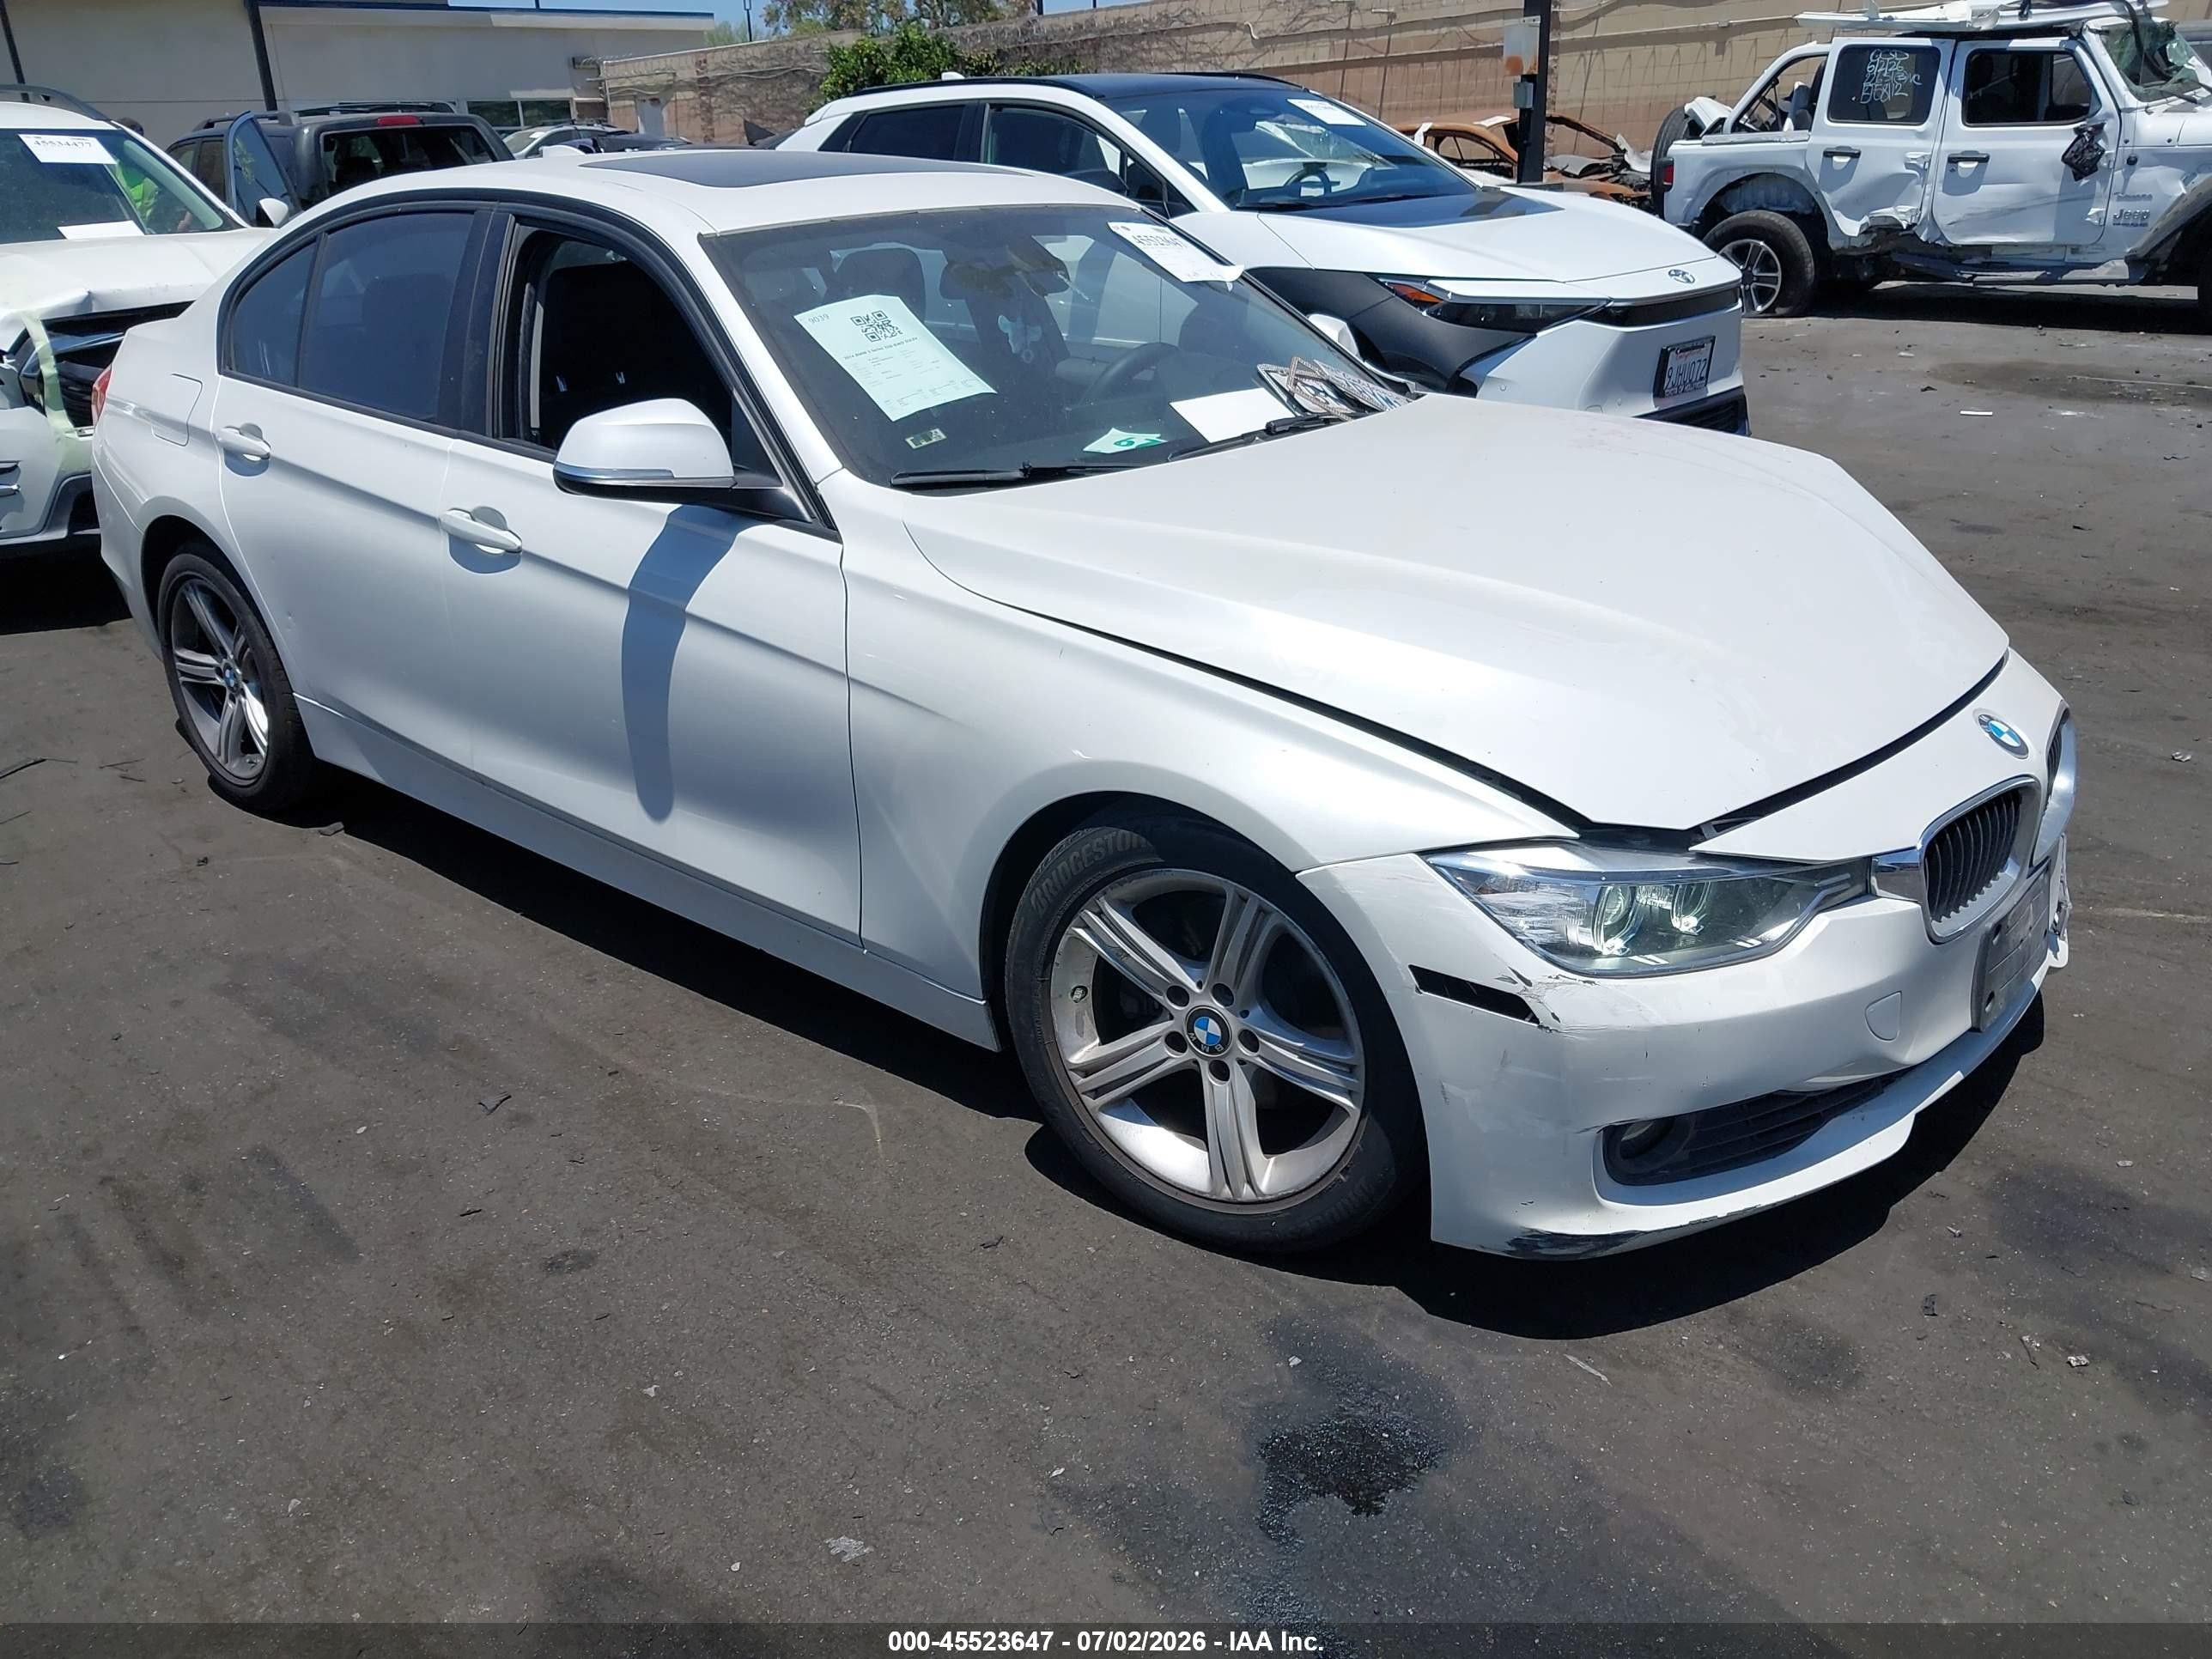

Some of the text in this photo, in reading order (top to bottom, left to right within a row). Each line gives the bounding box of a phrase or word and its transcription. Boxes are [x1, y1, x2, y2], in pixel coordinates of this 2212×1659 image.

[2113, 209, 2150, 221] Jeep
[808, 313, 830, 324] 9039
[1665, 358, 1707, 390] 9JHU072
[1030, 829, 1154, 918] BRIDGESTO
